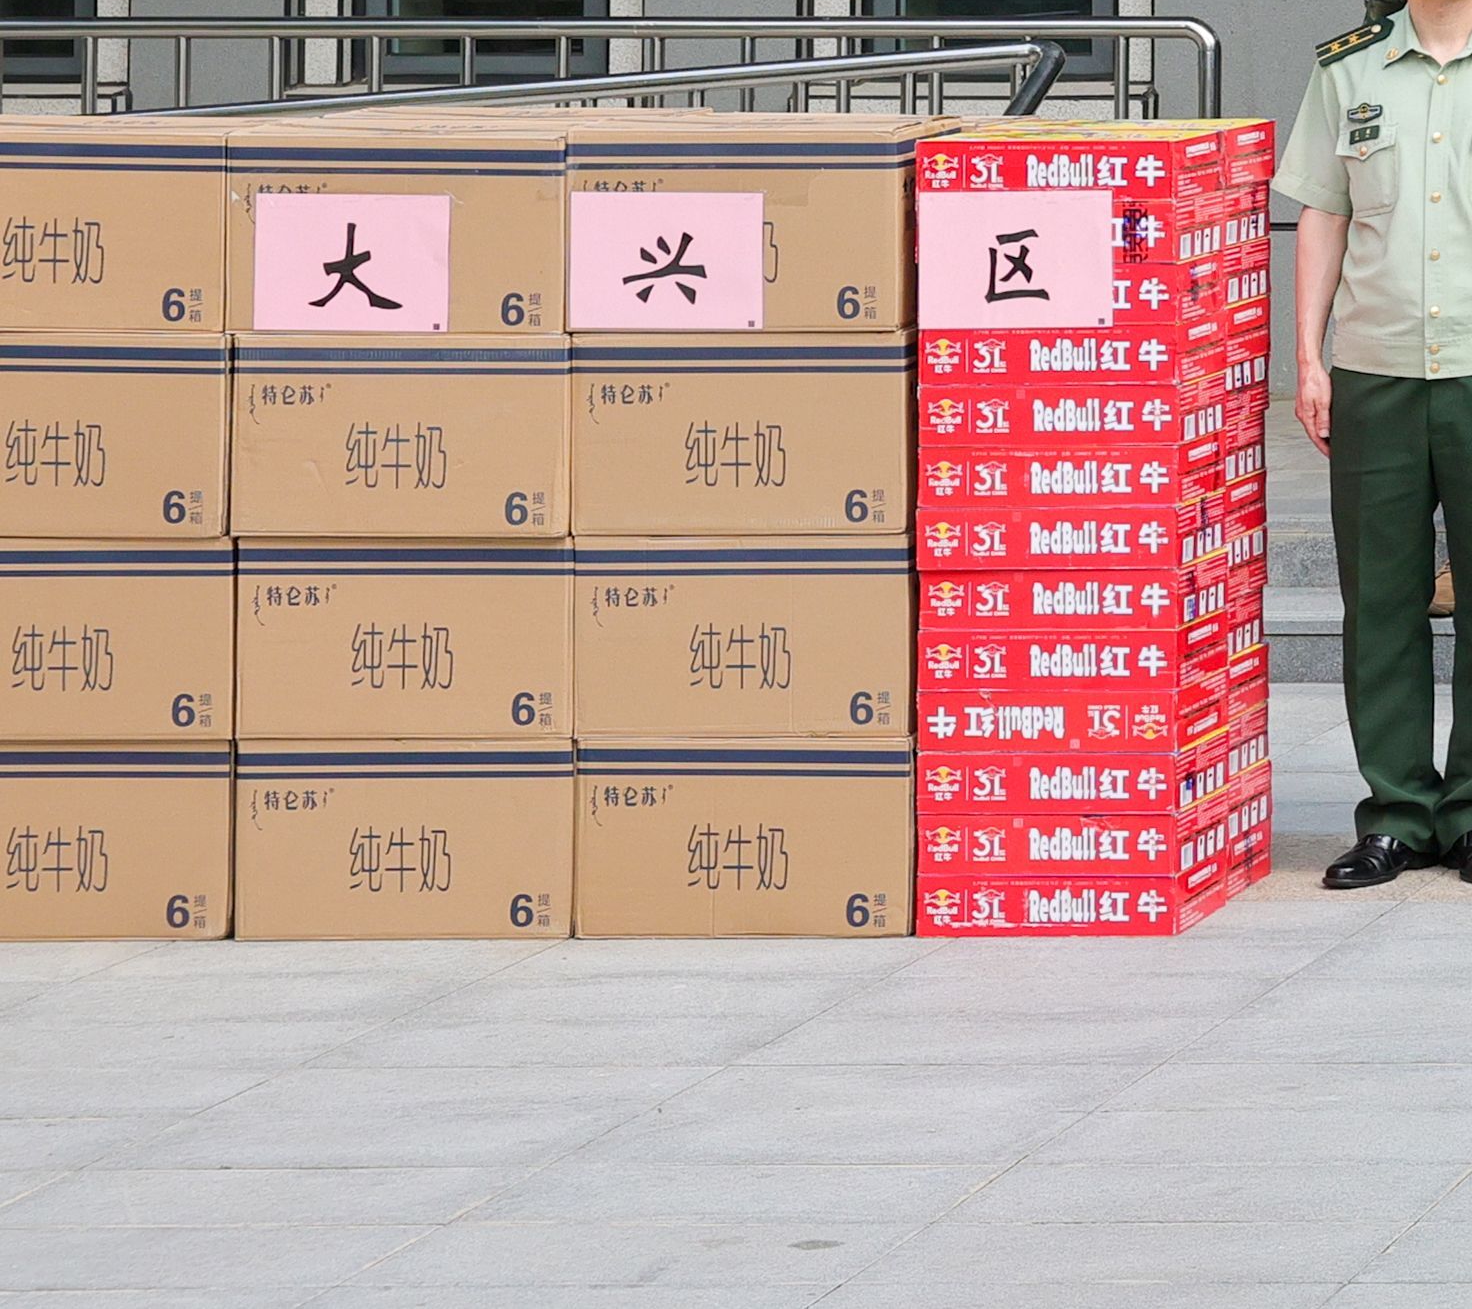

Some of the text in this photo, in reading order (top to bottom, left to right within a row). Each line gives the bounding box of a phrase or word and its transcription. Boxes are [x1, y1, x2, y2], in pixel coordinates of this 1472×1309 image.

[1097, 155, 1165, 185] 红牛
[2, 215, 104, 284] 纯牛奶
[308, 223, 403, 310] 大
[984, 229, 1050, 303] 区
[622, 232, 707, 305] 兴
[162, 288, 186, 322] 6
[501, 292, 524, 326] 6
[837, 286, 861, 319] 6
[1100, 340, 1168, 371] 红牛
[1104, 400, 1171, 431] 红牛
[5, 419, 105, 487] 纯牛奶
[345, 421, 446, 489] 纯牛奶
[685, 420, 786, 488] 纯牛奶
[1101, 462, 1168, 493] 红牛
[163, 491, 186, 524] 6
[504, 492, 528, 526] 6
[844, 490, 869, 523] 6
[1101, 522, 1168, 553] 红牛
[1103, 584, 1170, 615] 红牛
[11, 624, 113, 692] 纯牛奶
[351, 622, 453, 690] 纯牛奶
[690, 622, 791, 689] 纯牛奶
[1100, 645, 1168, 677] 红牛
[172, 694, 195, 727] 6
[511, 692, 535, 726] 6
[849, 691, 873, 725] 6
[1099, 768, 1166, 800] 红牛
[6, 825, 108, 892] 纯牛奶
[349, 825, 451, 893] 纯牛奶
[688, 823, 788, 891] 纯牛奶
[1099, 828, 1166, 860] 红牛
[166, 895, 190, 928] 6
[510, 894, 533, 928] 6
[845, 893, 870, 927] 6
[1099, 890, 1166, 922] 红牛
